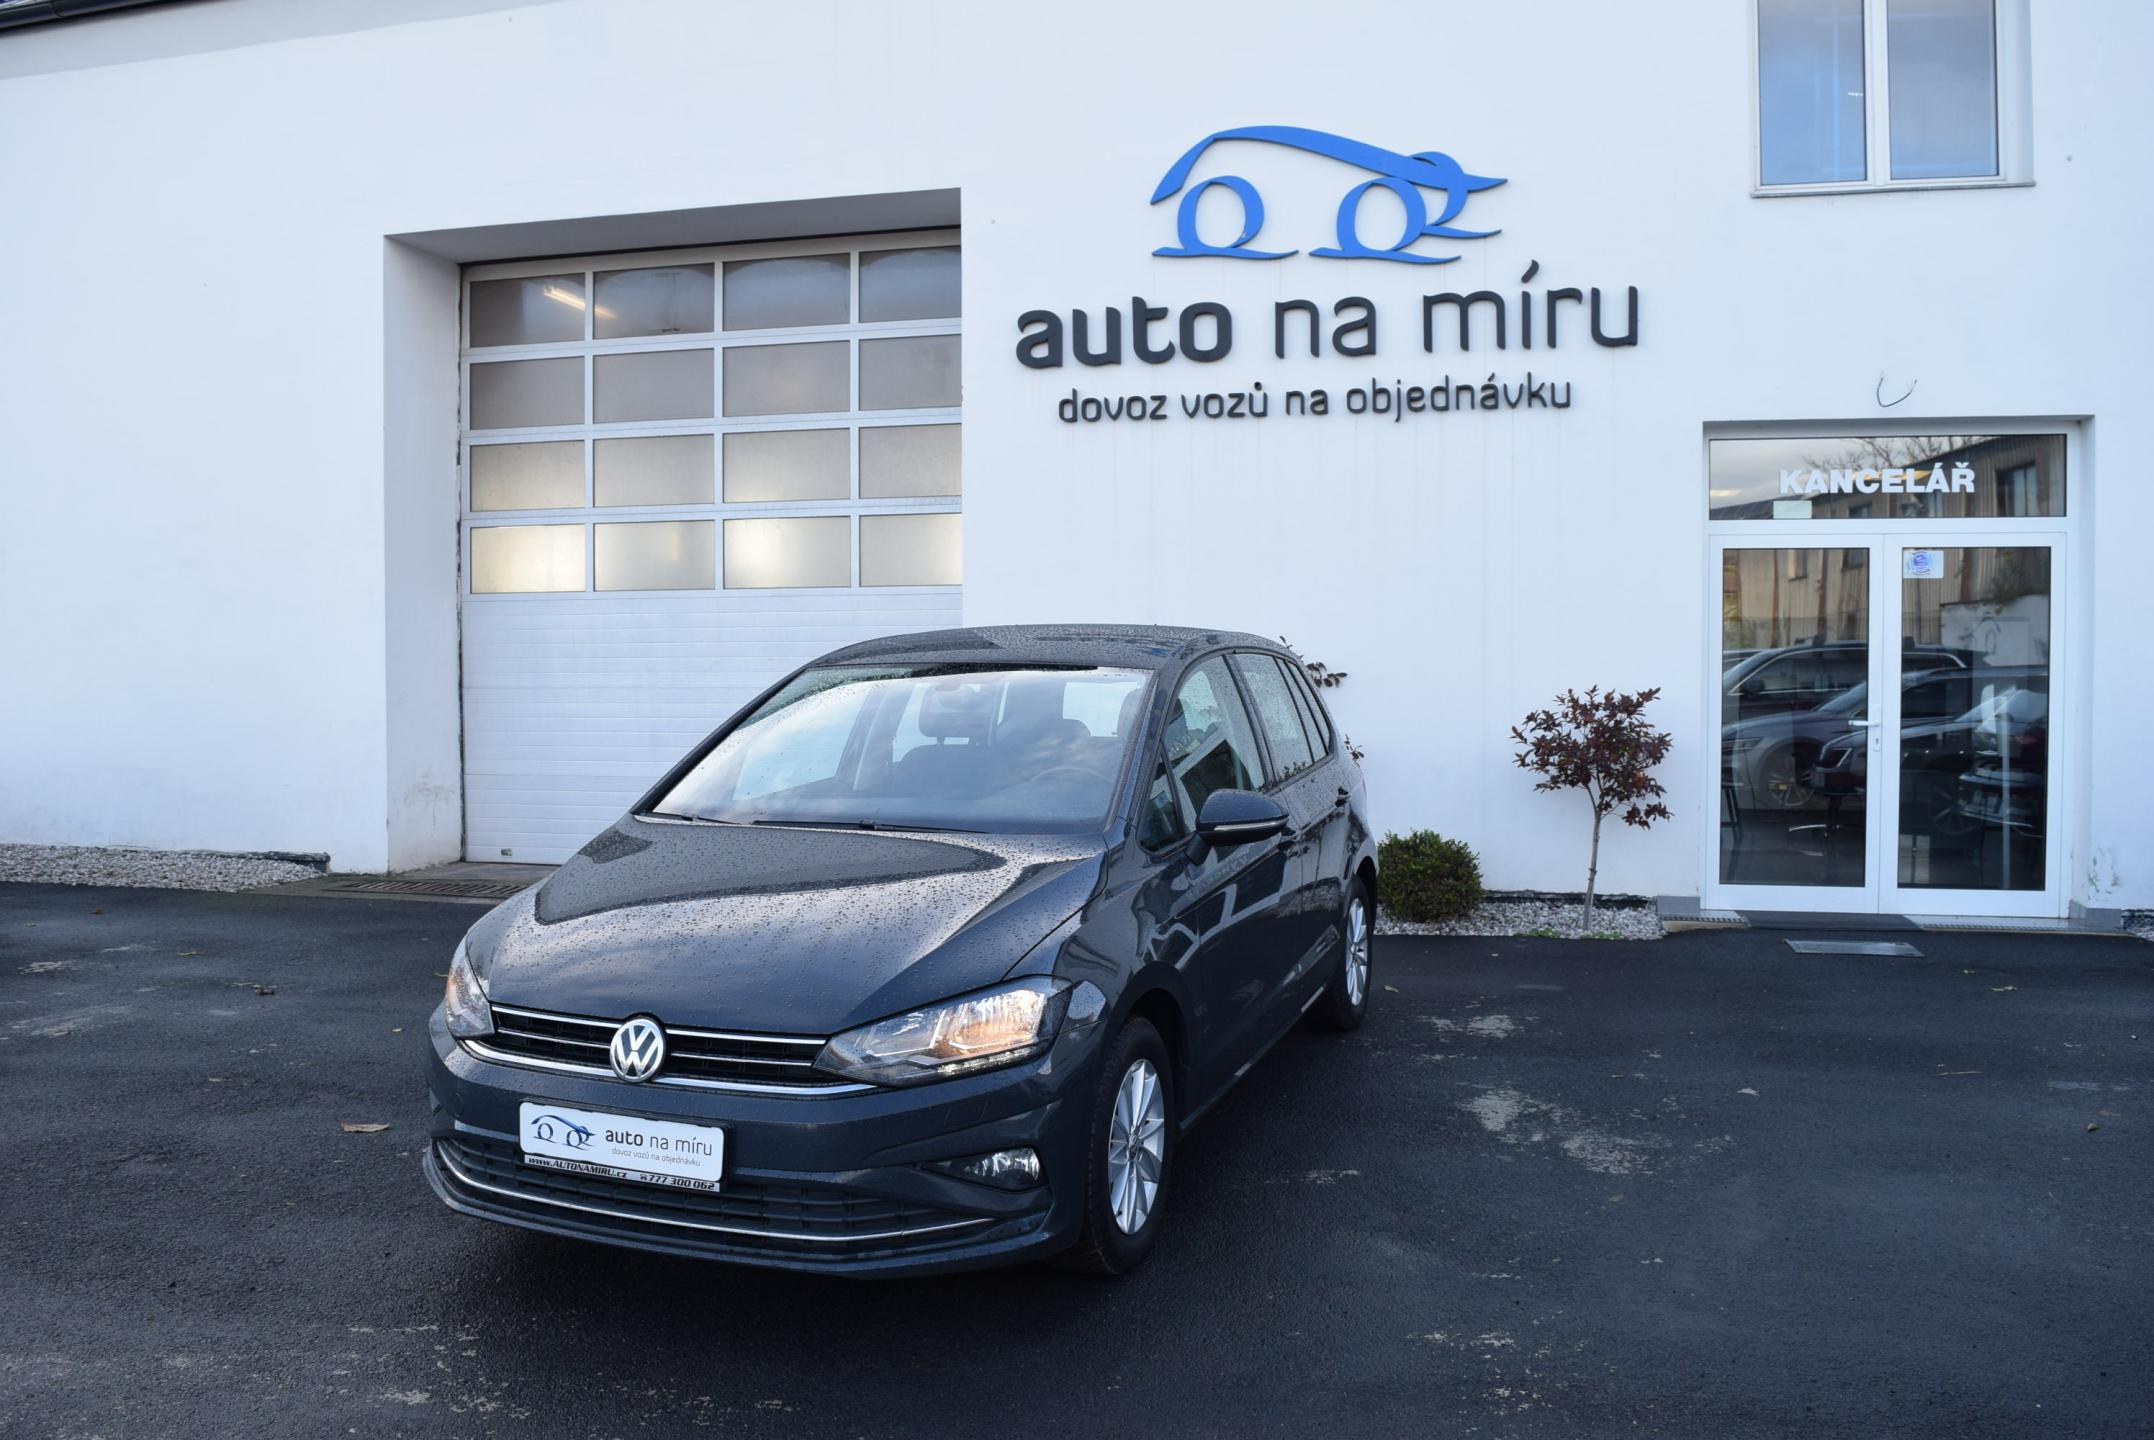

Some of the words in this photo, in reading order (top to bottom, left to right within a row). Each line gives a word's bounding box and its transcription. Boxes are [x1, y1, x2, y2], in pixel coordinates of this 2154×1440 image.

[1015, 297, 1233, 370] auto
[1275, 297, 1377, 360] na
[1423, 260, 1639, 353] míru
[1058, 388, 1168, 423] dovoz
[1181, 382, 1269, 420] vozů
[1285, 390, 1329, 417] na
[1347, 372, 1571, 423] objednávku
[1779, 462, 1975, 494] KANCELÁŘ
[605, 1129, 644, 1146] auto
[650, 1136, 669, 1150] na
[675, 1136, 712, 1156] míru
[612, 1147, 632, 1157] dovoz
[649, 1174, 668, 1184] 777
[670, 1177, 691, 1187] 300
[693, 1181, 715, 1190] 062
